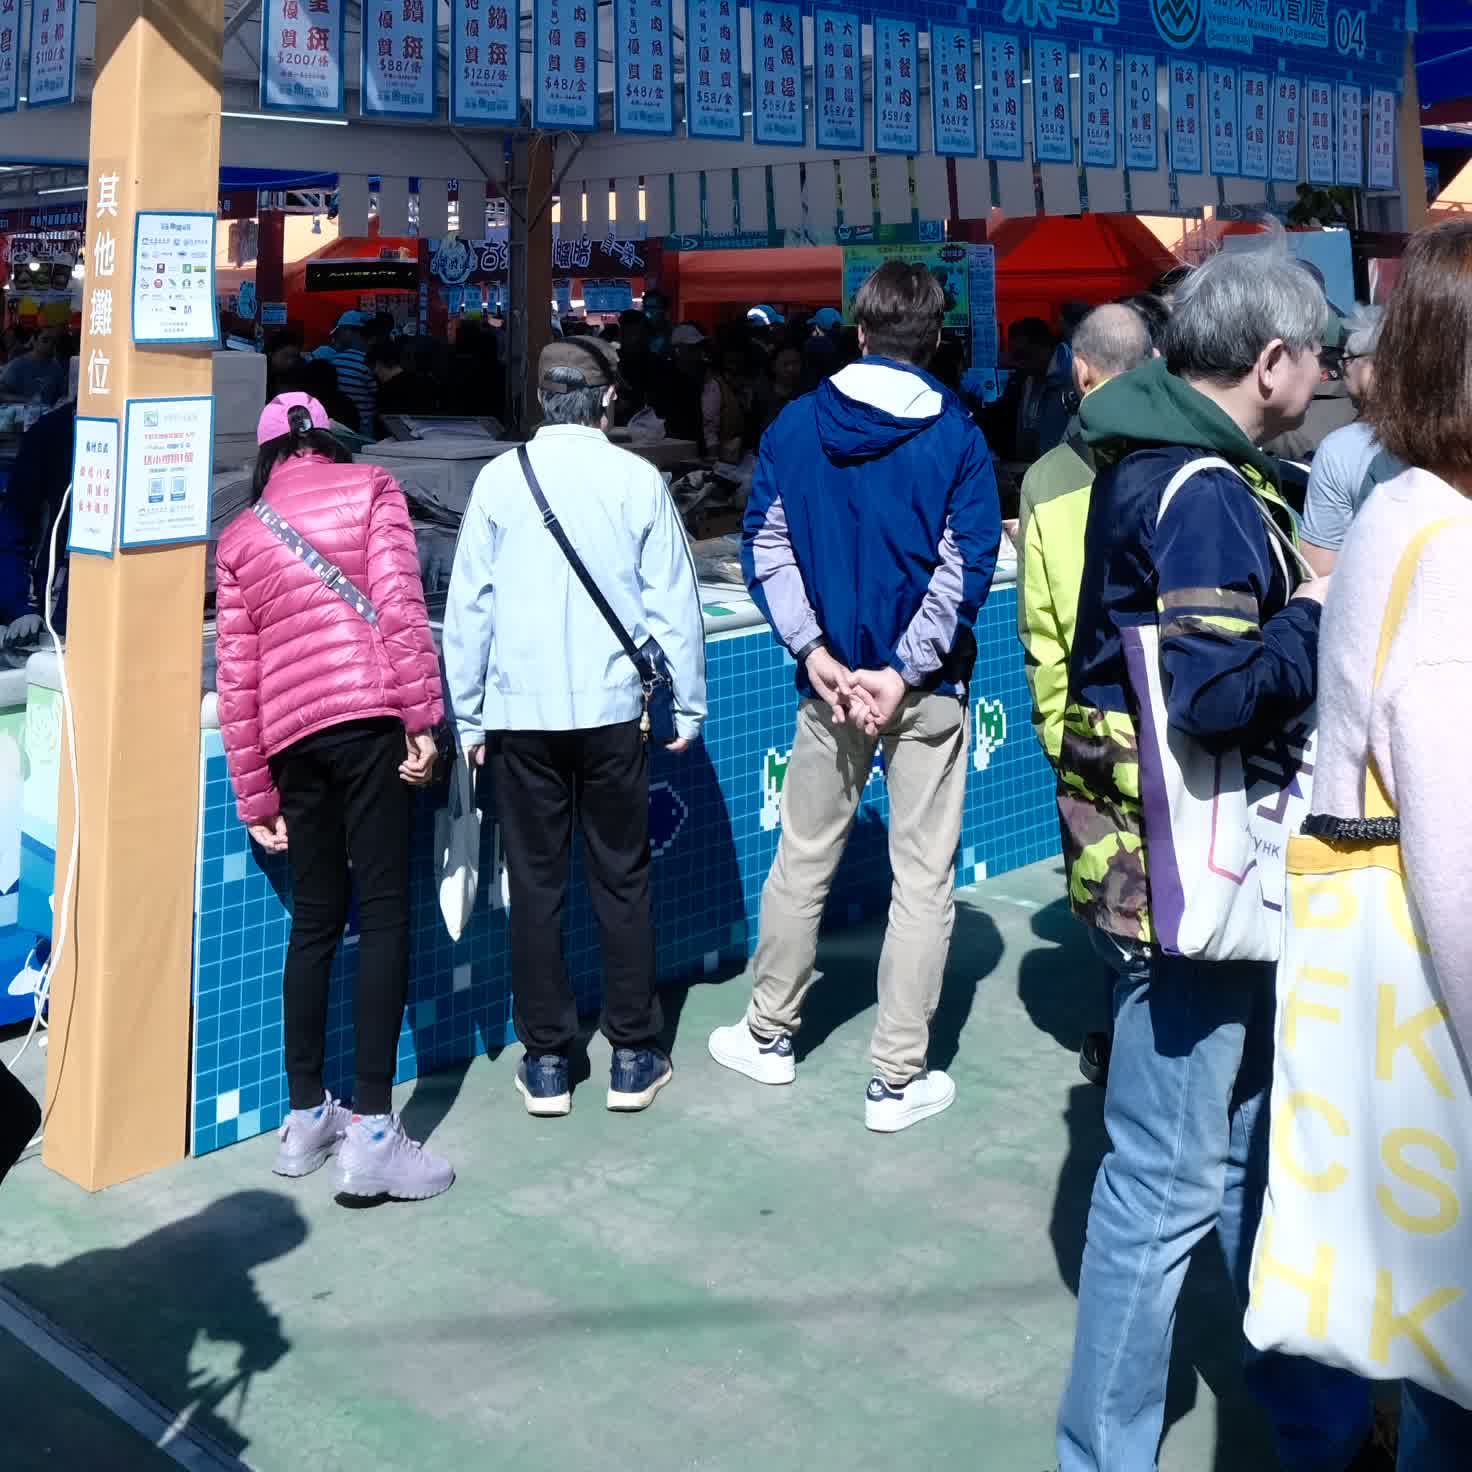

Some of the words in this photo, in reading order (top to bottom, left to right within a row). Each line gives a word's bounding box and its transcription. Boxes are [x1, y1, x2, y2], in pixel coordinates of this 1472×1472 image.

[898, 27, 912, 108] 午餐肉
[953, 33, 969, 111] 午餐肉
[1336, 10, 1366, 55] 04
[1003, 41, 1017, 116] 午餐肉
[1051, 47, 1065, 121] 午餐肉
[88, 171, 120, 396] 其他攤位
[1374, 982, 1458, 1100] K
[1272, 1090, 1351, 1192] C
[1375, 1126, 1461, 1235] S
[1365, 1267, 1465, 1380] K
